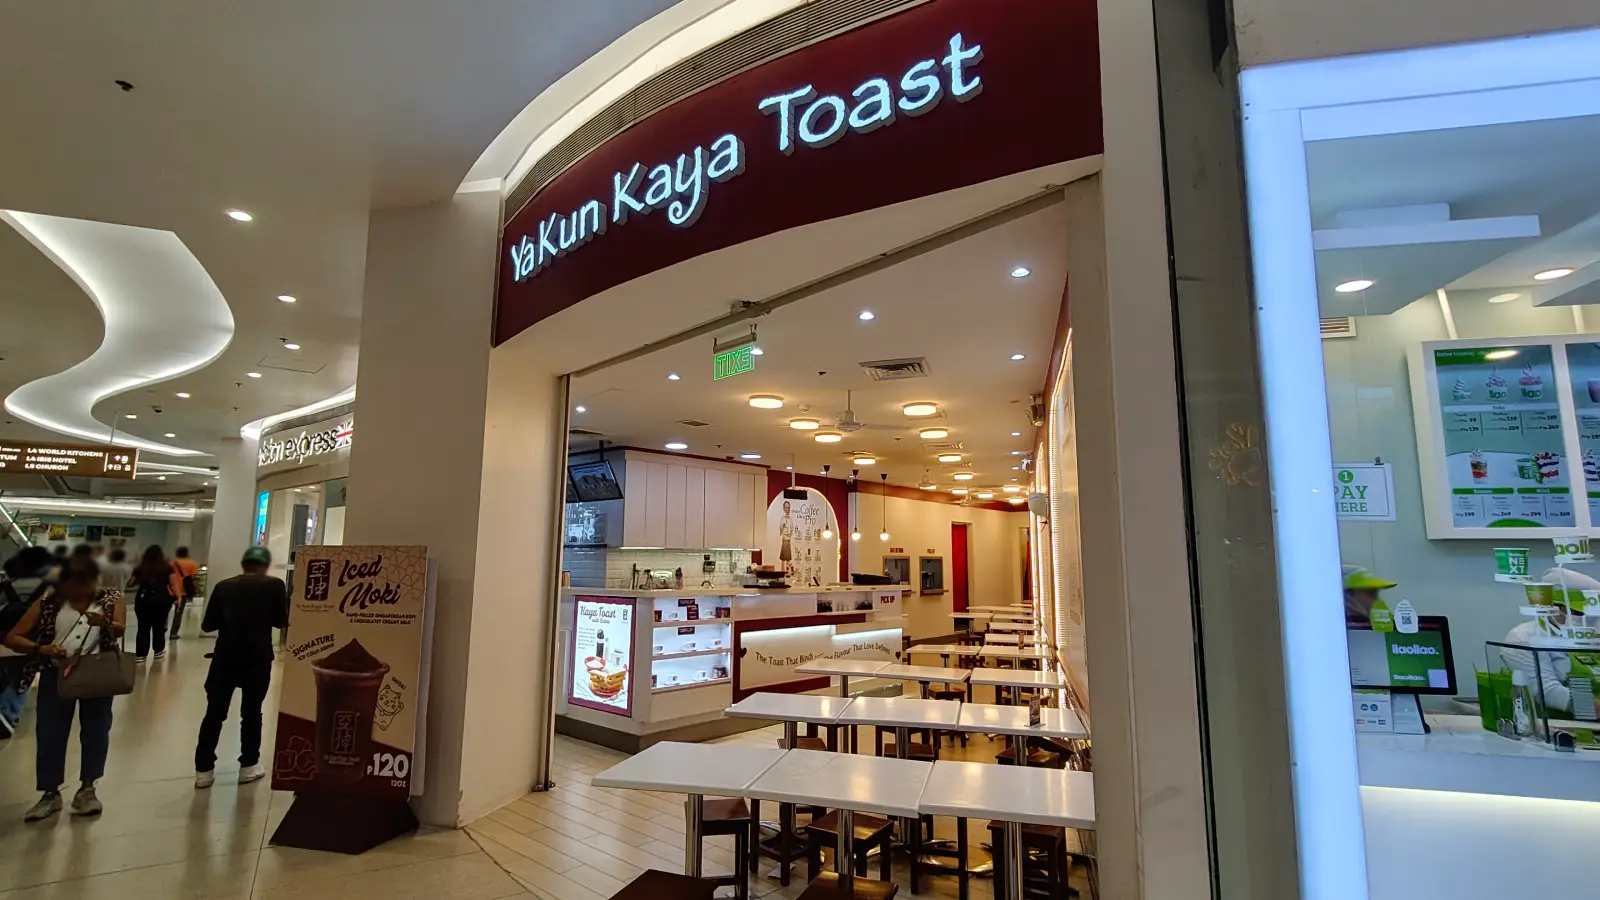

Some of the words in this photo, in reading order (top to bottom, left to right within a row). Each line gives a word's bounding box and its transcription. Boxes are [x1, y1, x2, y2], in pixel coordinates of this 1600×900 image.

[612, 132, 741, 228] Kaya
[758, 32, 983, 152] Toast
[66, 449, 104, 458] KITCHENS
[285, 428, 338, 464] express
[800, 503, 820, 517] Coffee
[805, 515, 816, 525] Pro
[337, 554, 383, 588] Iced
[338, 582, 401, 614] Moki
[580, 605, 598, 620] Kaya
[598, 606, 616, 619] Toast
[292, 633, 335, 657] SIGNATURE
[756, 651, 768, 664] The
[768, 656, 785, 666] Toast
[785, 656, 799, 666] That
[799, 652, 814, 664] Binds
[833, 647, 852, 660] Flavour
[852, 643, 863, 653] That
[863, 642, 875, 650] Love
